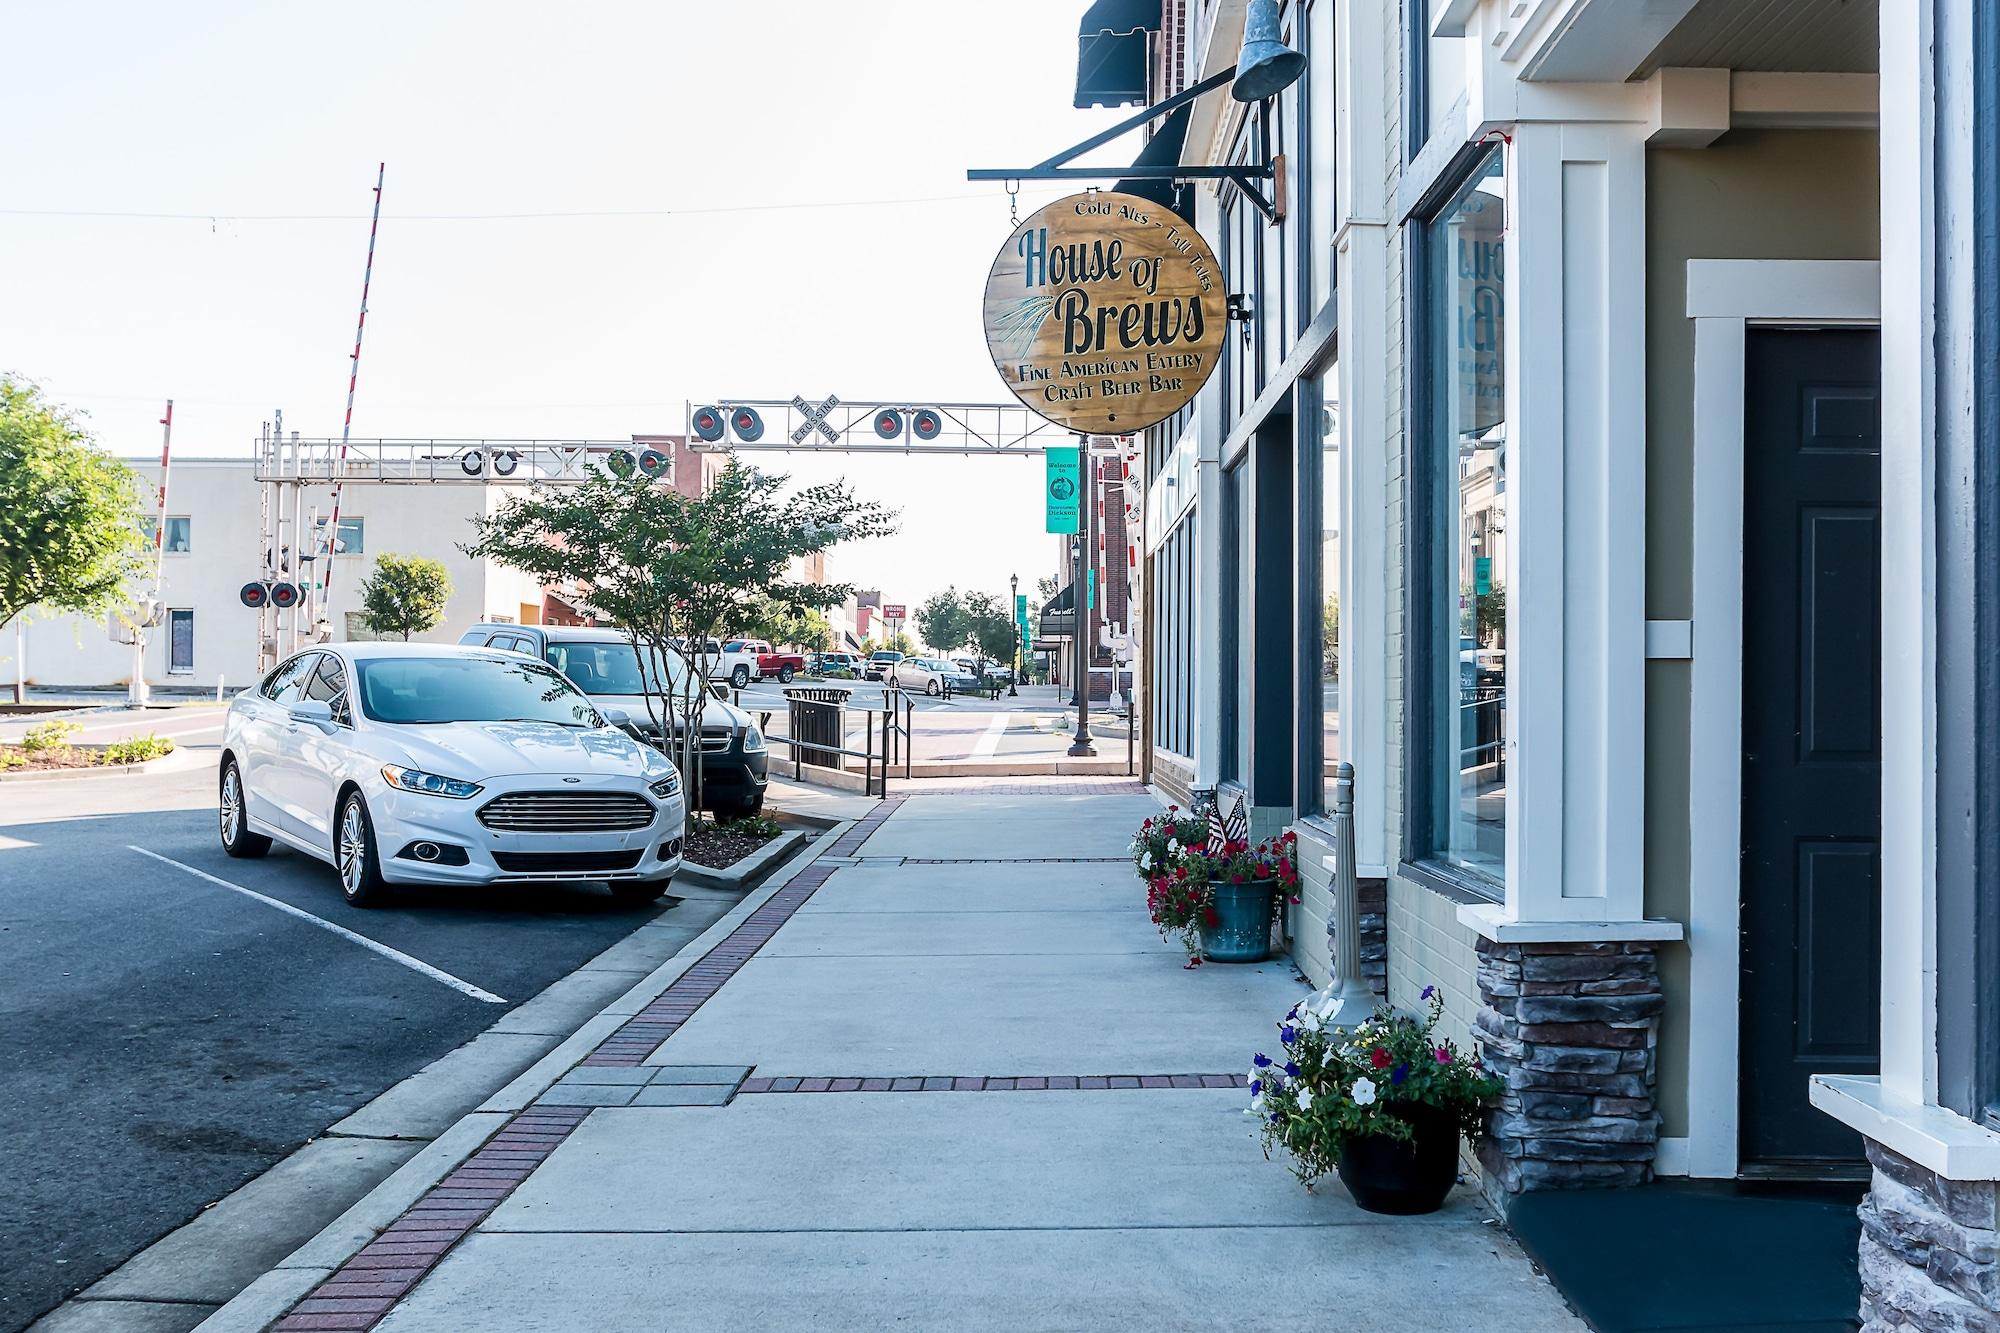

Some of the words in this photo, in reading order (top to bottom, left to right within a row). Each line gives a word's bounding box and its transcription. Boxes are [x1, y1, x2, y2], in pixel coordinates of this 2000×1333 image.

[1075, 202, 1111, 215] Cold
[1018, 228, 1122, 287] House
[1054, 288, 1205, 355] Brews
[792, 396, 810, 416] RAIL
[818, 421, 838, 441] ROAD
[795, 398, 836, 441] CROSSING
